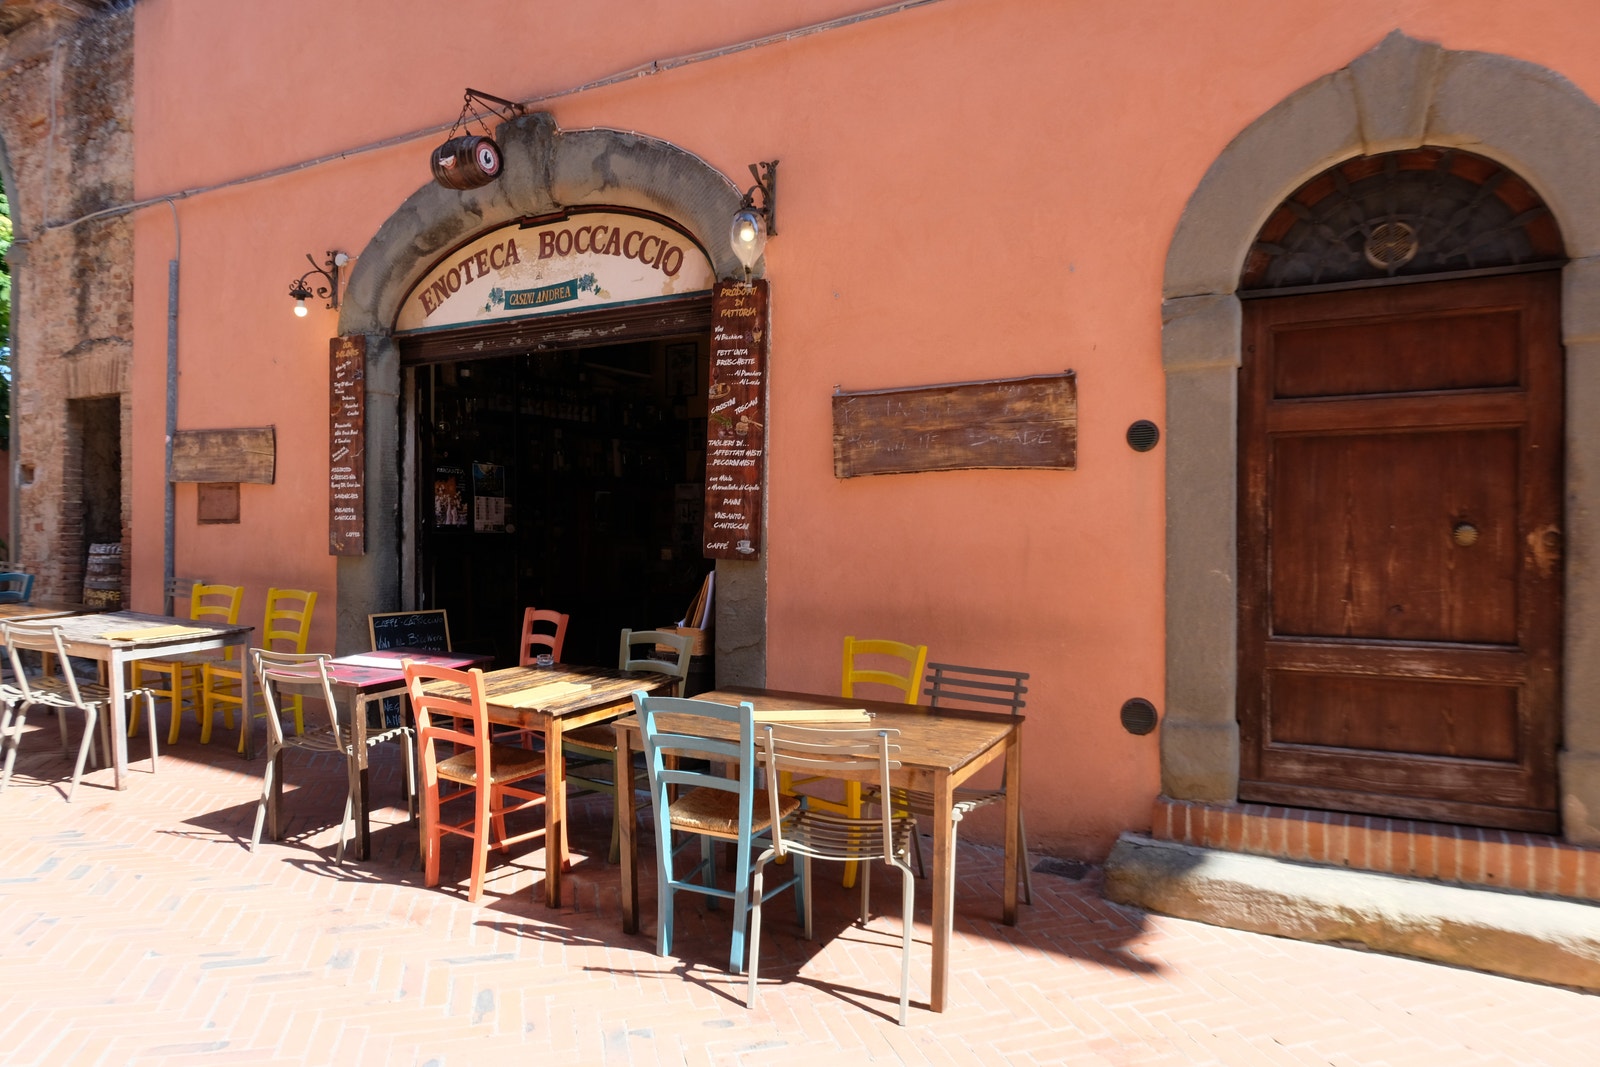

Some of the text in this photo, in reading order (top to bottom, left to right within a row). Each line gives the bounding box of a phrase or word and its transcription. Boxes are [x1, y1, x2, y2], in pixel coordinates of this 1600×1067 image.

[418, 225, 684, 317] ENOTECA BOCCACCIO
[509, 286, 571, 306] CASINI ANDREA
[735, 297, 744, 307] DI
[720, 307, 757, 317] FATTORIA
